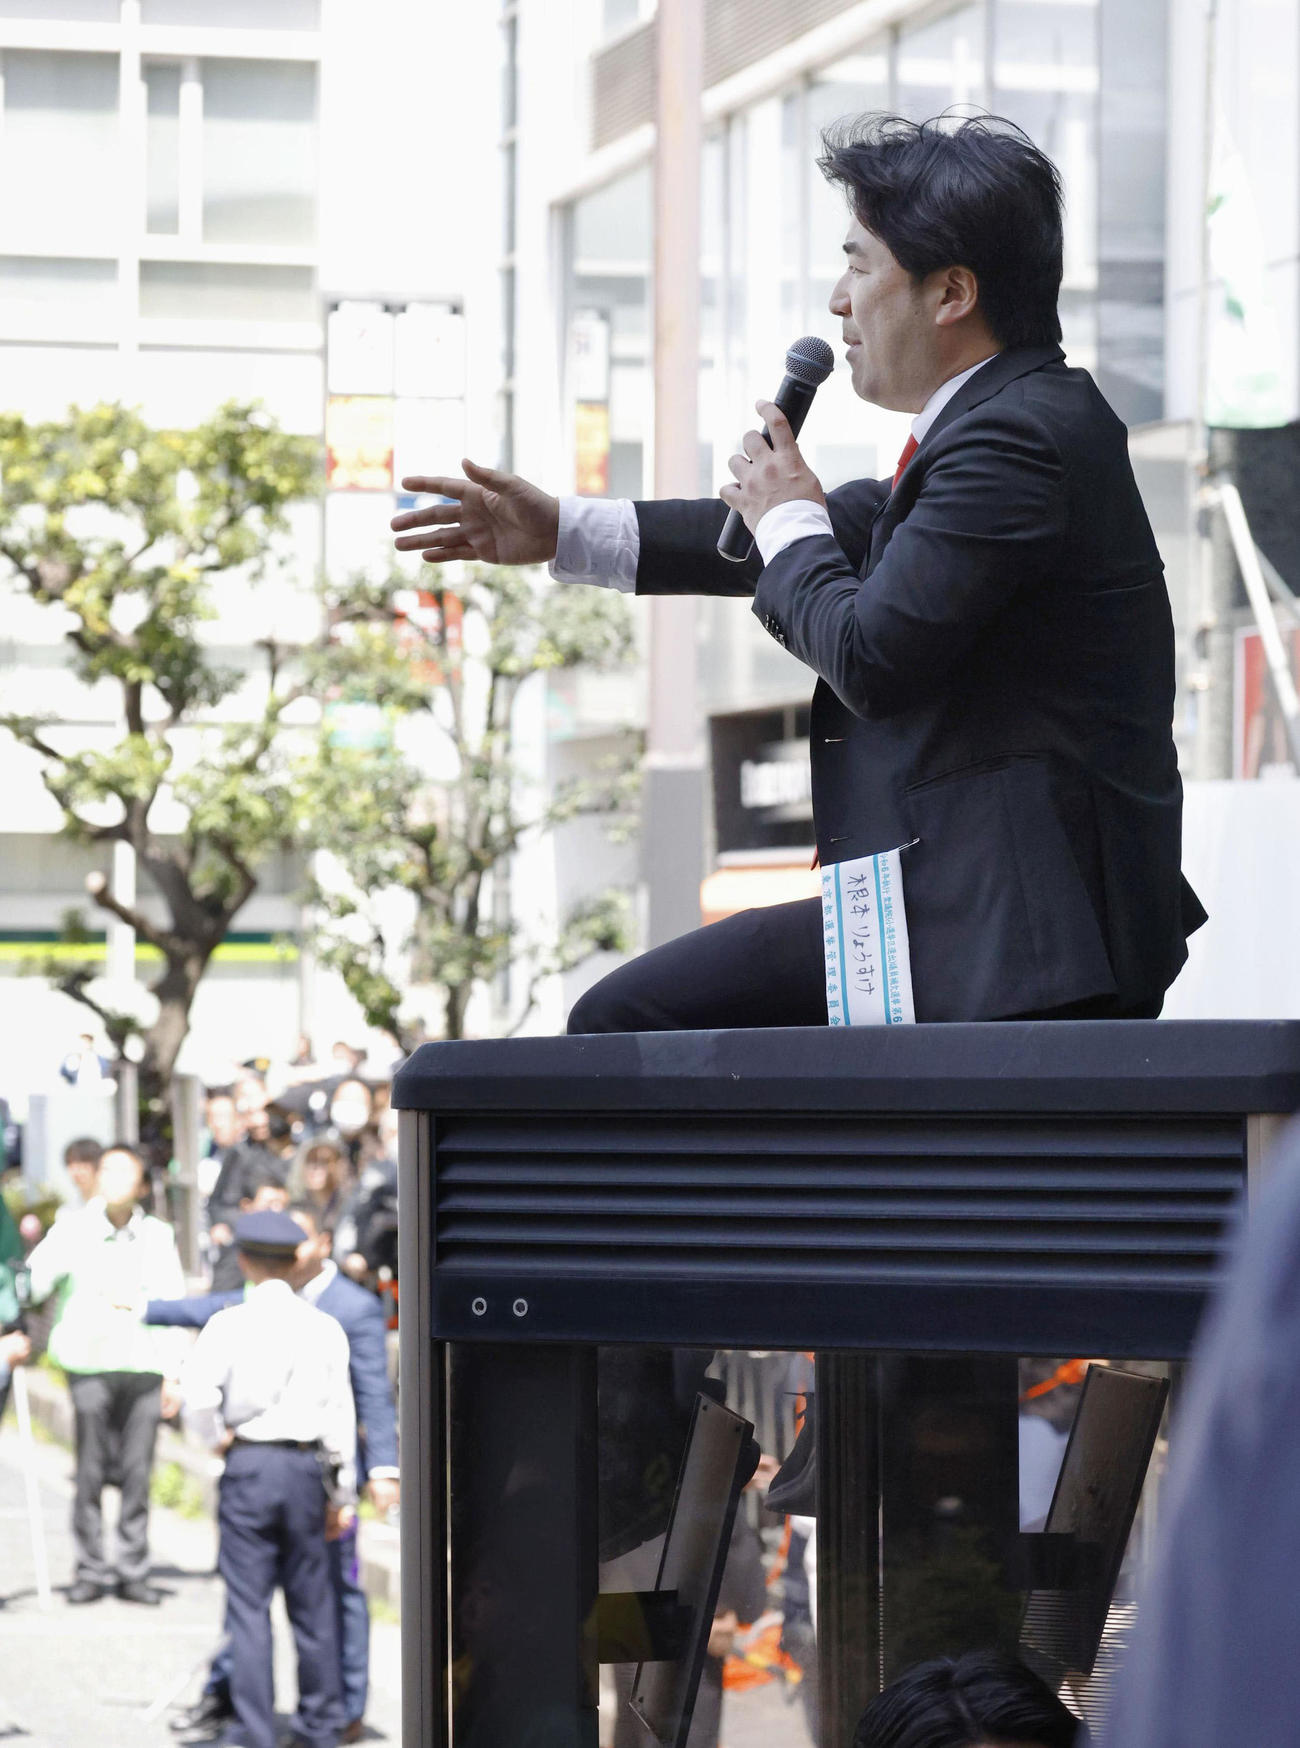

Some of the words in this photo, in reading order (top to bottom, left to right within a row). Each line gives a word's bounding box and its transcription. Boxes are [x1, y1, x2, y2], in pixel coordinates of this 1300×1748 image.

[847, 873, 870, 918] 根本
[822, 874, 840, 1025] 東京都選挙管理委員会
[852, 926, 875, 995] りょうすけ
